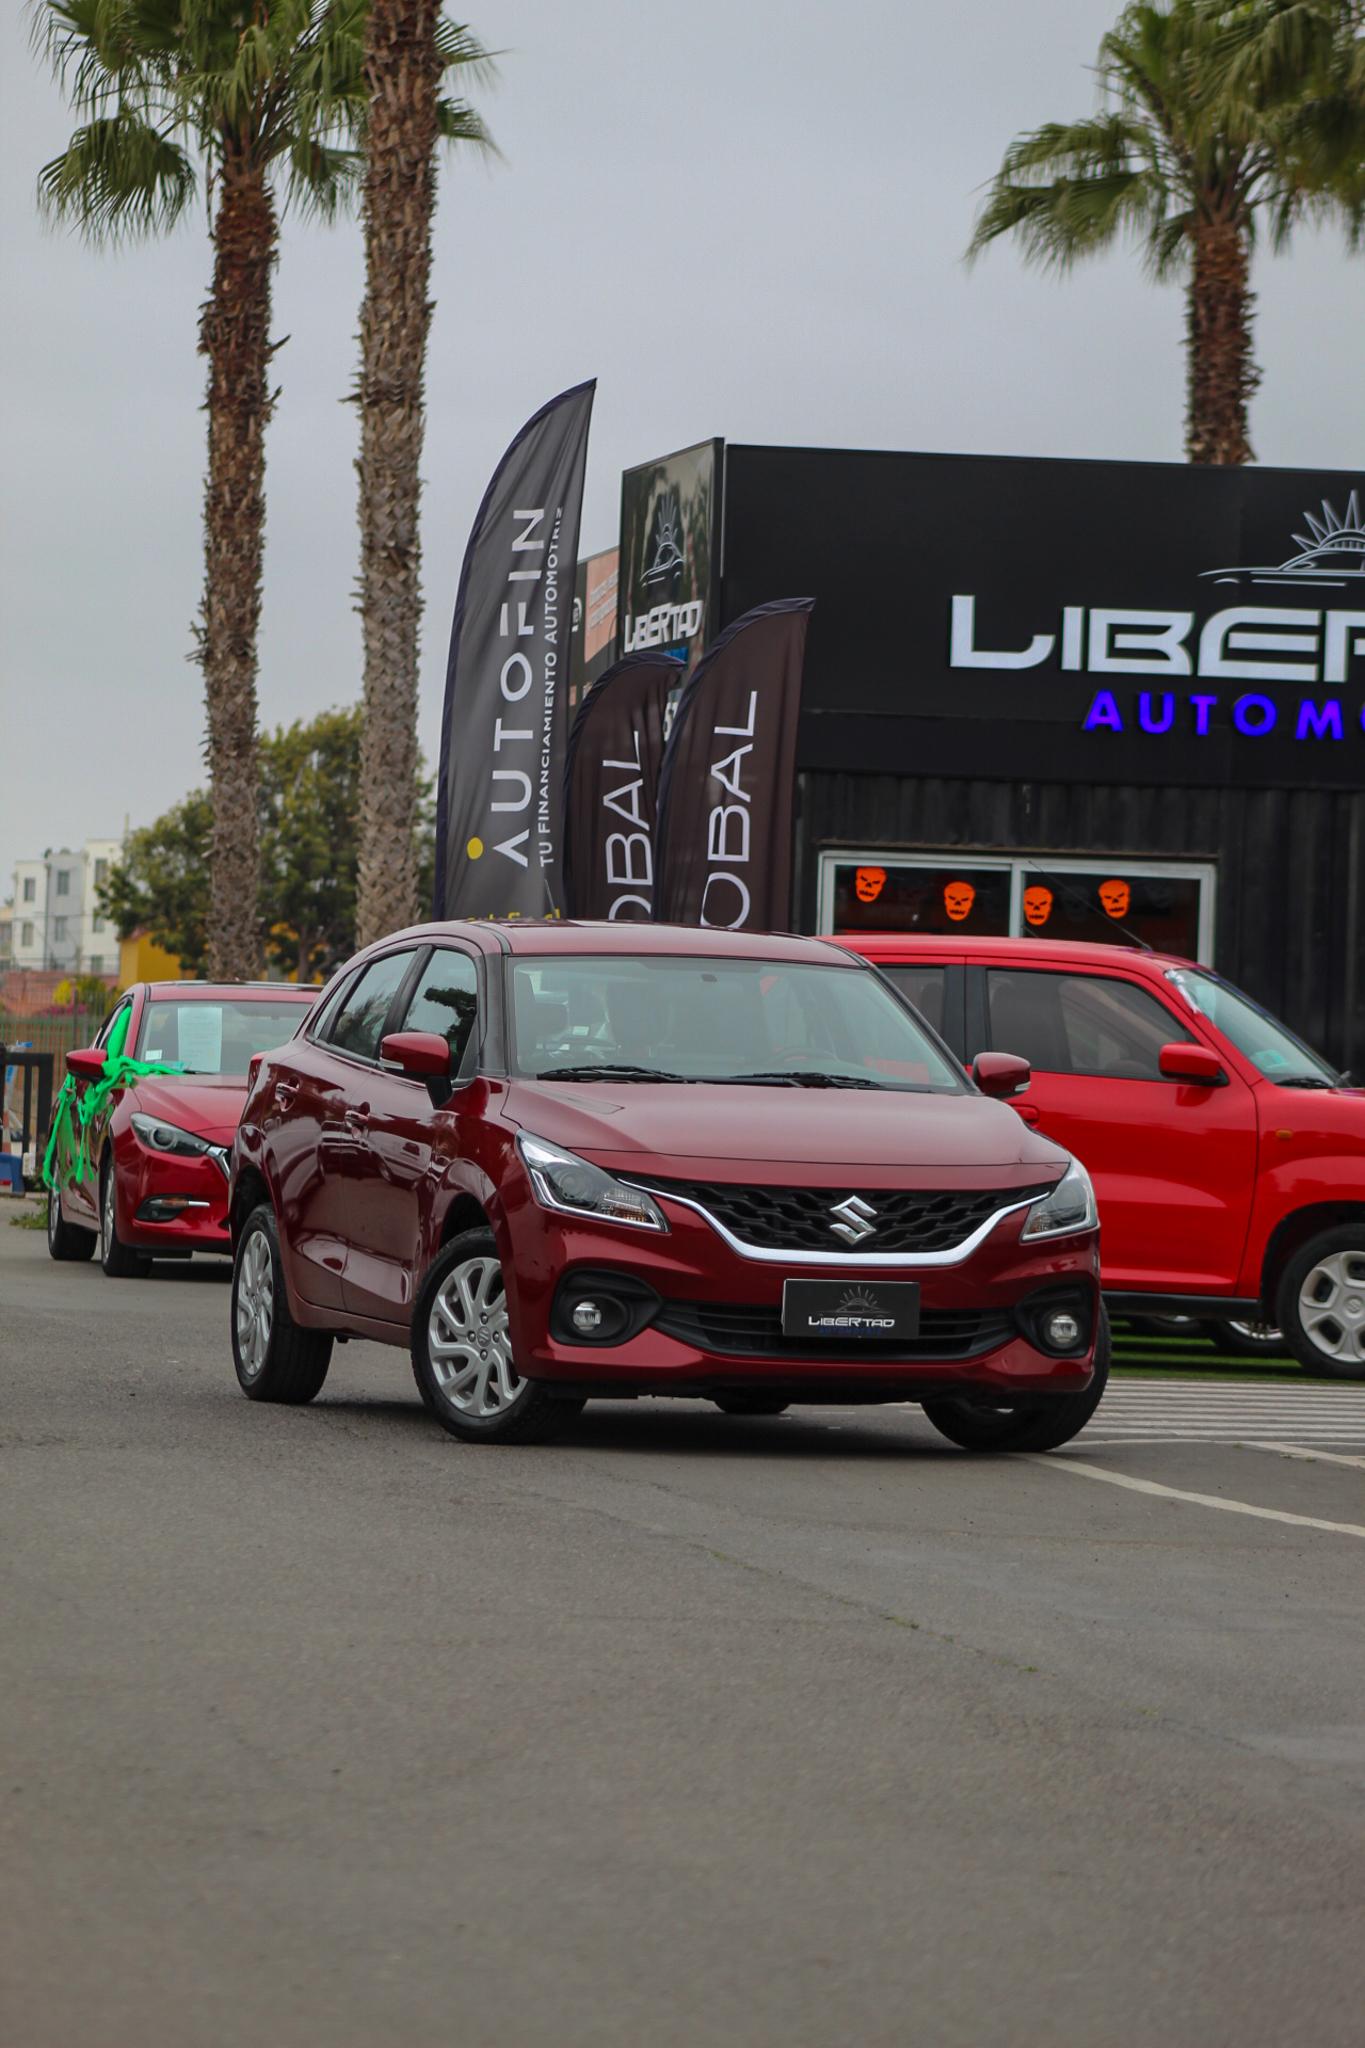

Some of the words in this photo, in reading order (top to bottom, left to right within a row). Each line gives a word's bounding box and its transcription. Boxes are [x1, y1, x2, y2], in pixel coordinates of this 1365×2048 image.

[544, 506, 564, 644] AUTOMOTRIZ
[1081, 689, 1365, 741] AUTOM
[538, 652, 558, 834] FINANCIAMIENTO
[538, 841, 554, 867] TU
[807, 1315, 896, 1328] LIBERTAD
